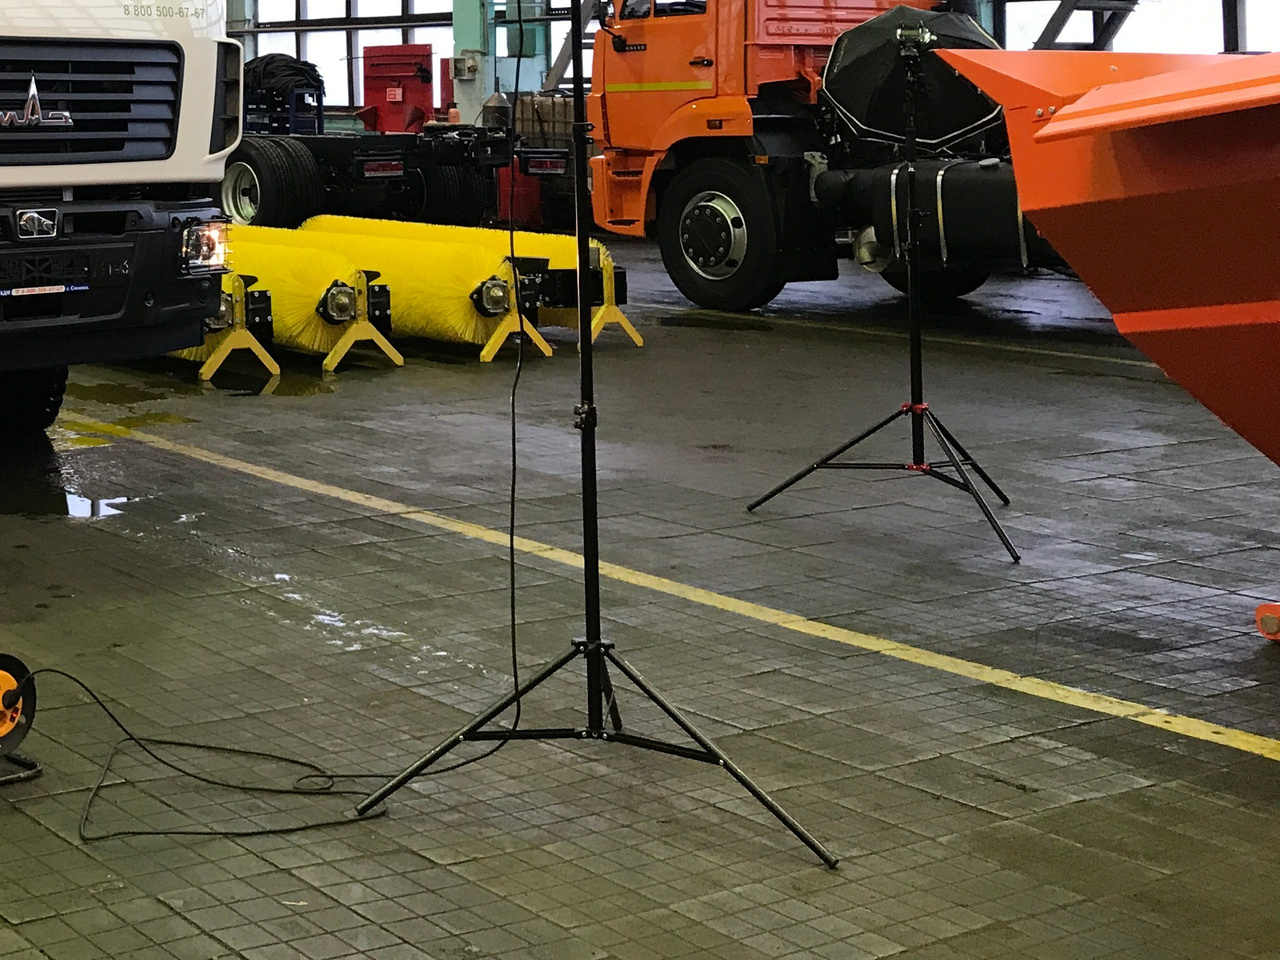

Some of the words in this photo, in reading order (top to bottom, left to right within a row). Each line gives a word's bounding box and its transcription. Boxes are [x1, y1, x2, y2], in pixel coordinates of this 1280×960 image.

[123, 4, 131, 16] 8
[133, 5, 153, 17] 800
[156, 6, 205, 19] 500-67-67
